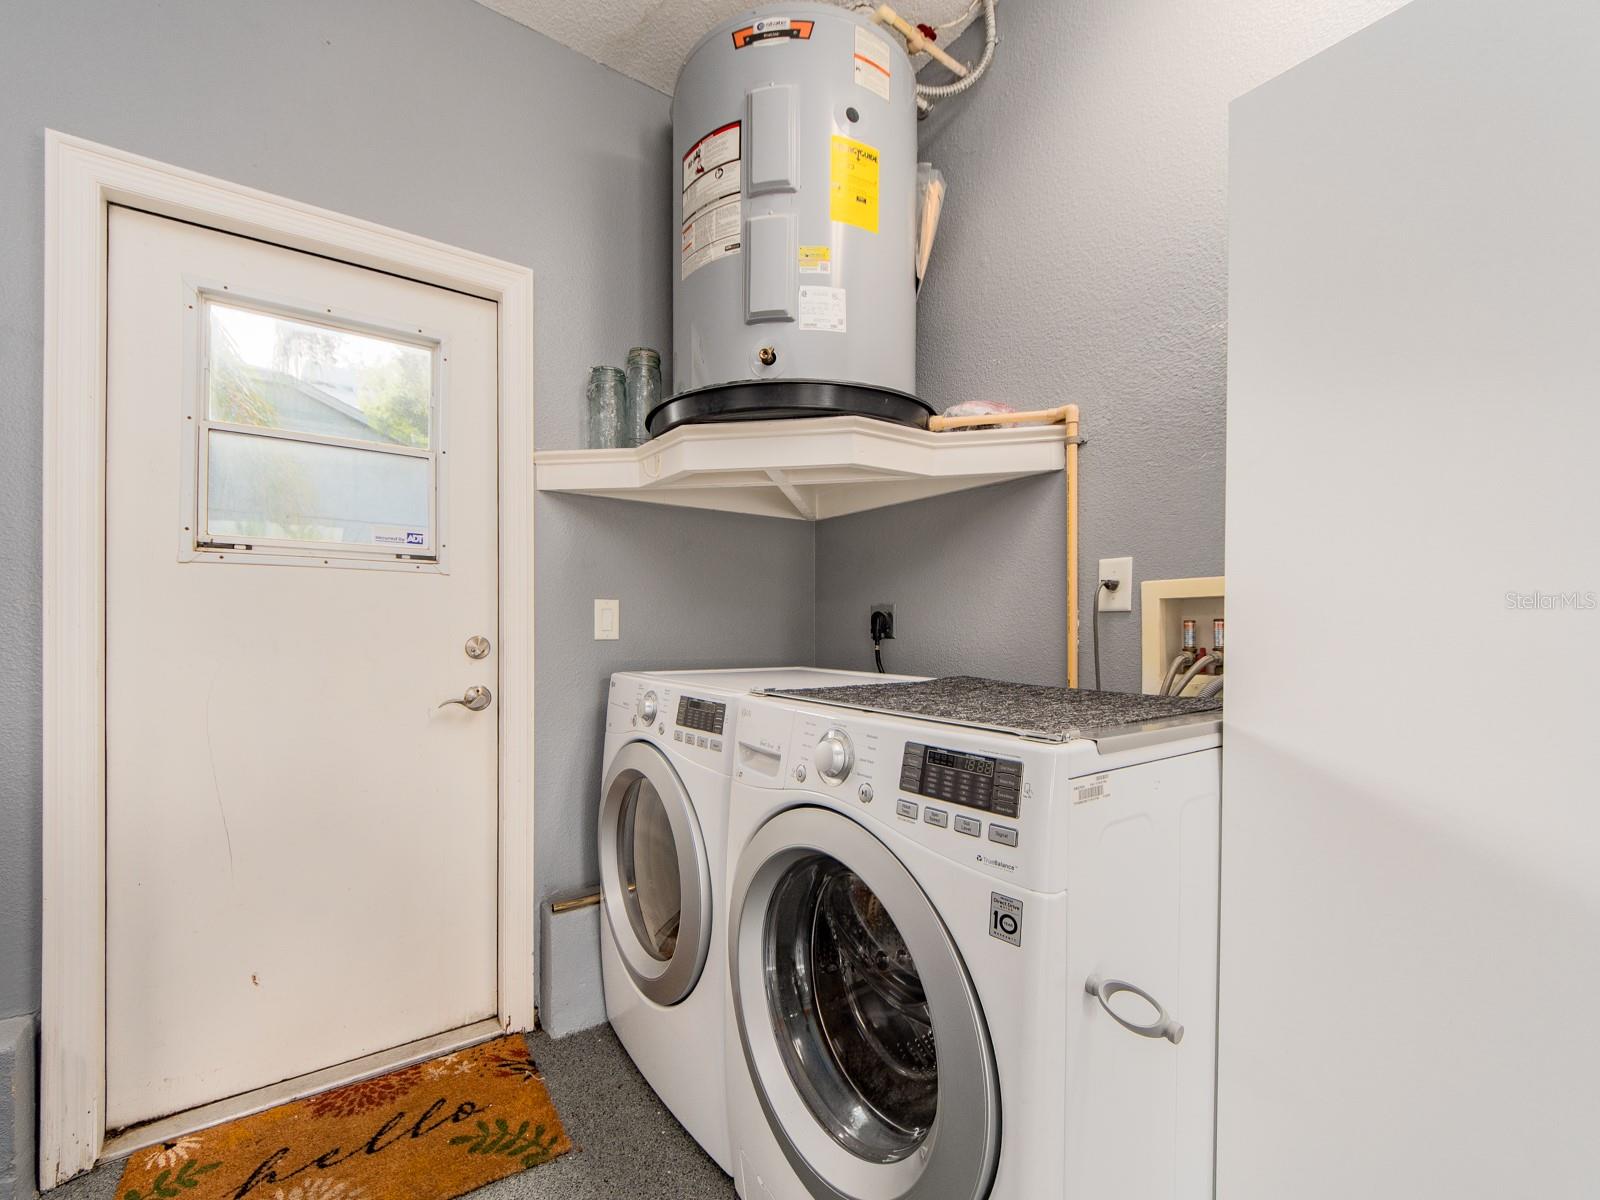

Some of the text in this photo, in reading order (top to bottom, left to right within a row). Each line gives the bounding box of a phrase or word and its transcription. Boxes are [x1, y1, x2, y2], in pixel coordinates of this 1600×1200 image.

[407, 532, 423, 544] ADT
[1007, 902, 1020, 911] Drive
[993, 910, 1018, 935] 10
[221, 1098, 492, 1200] hello
